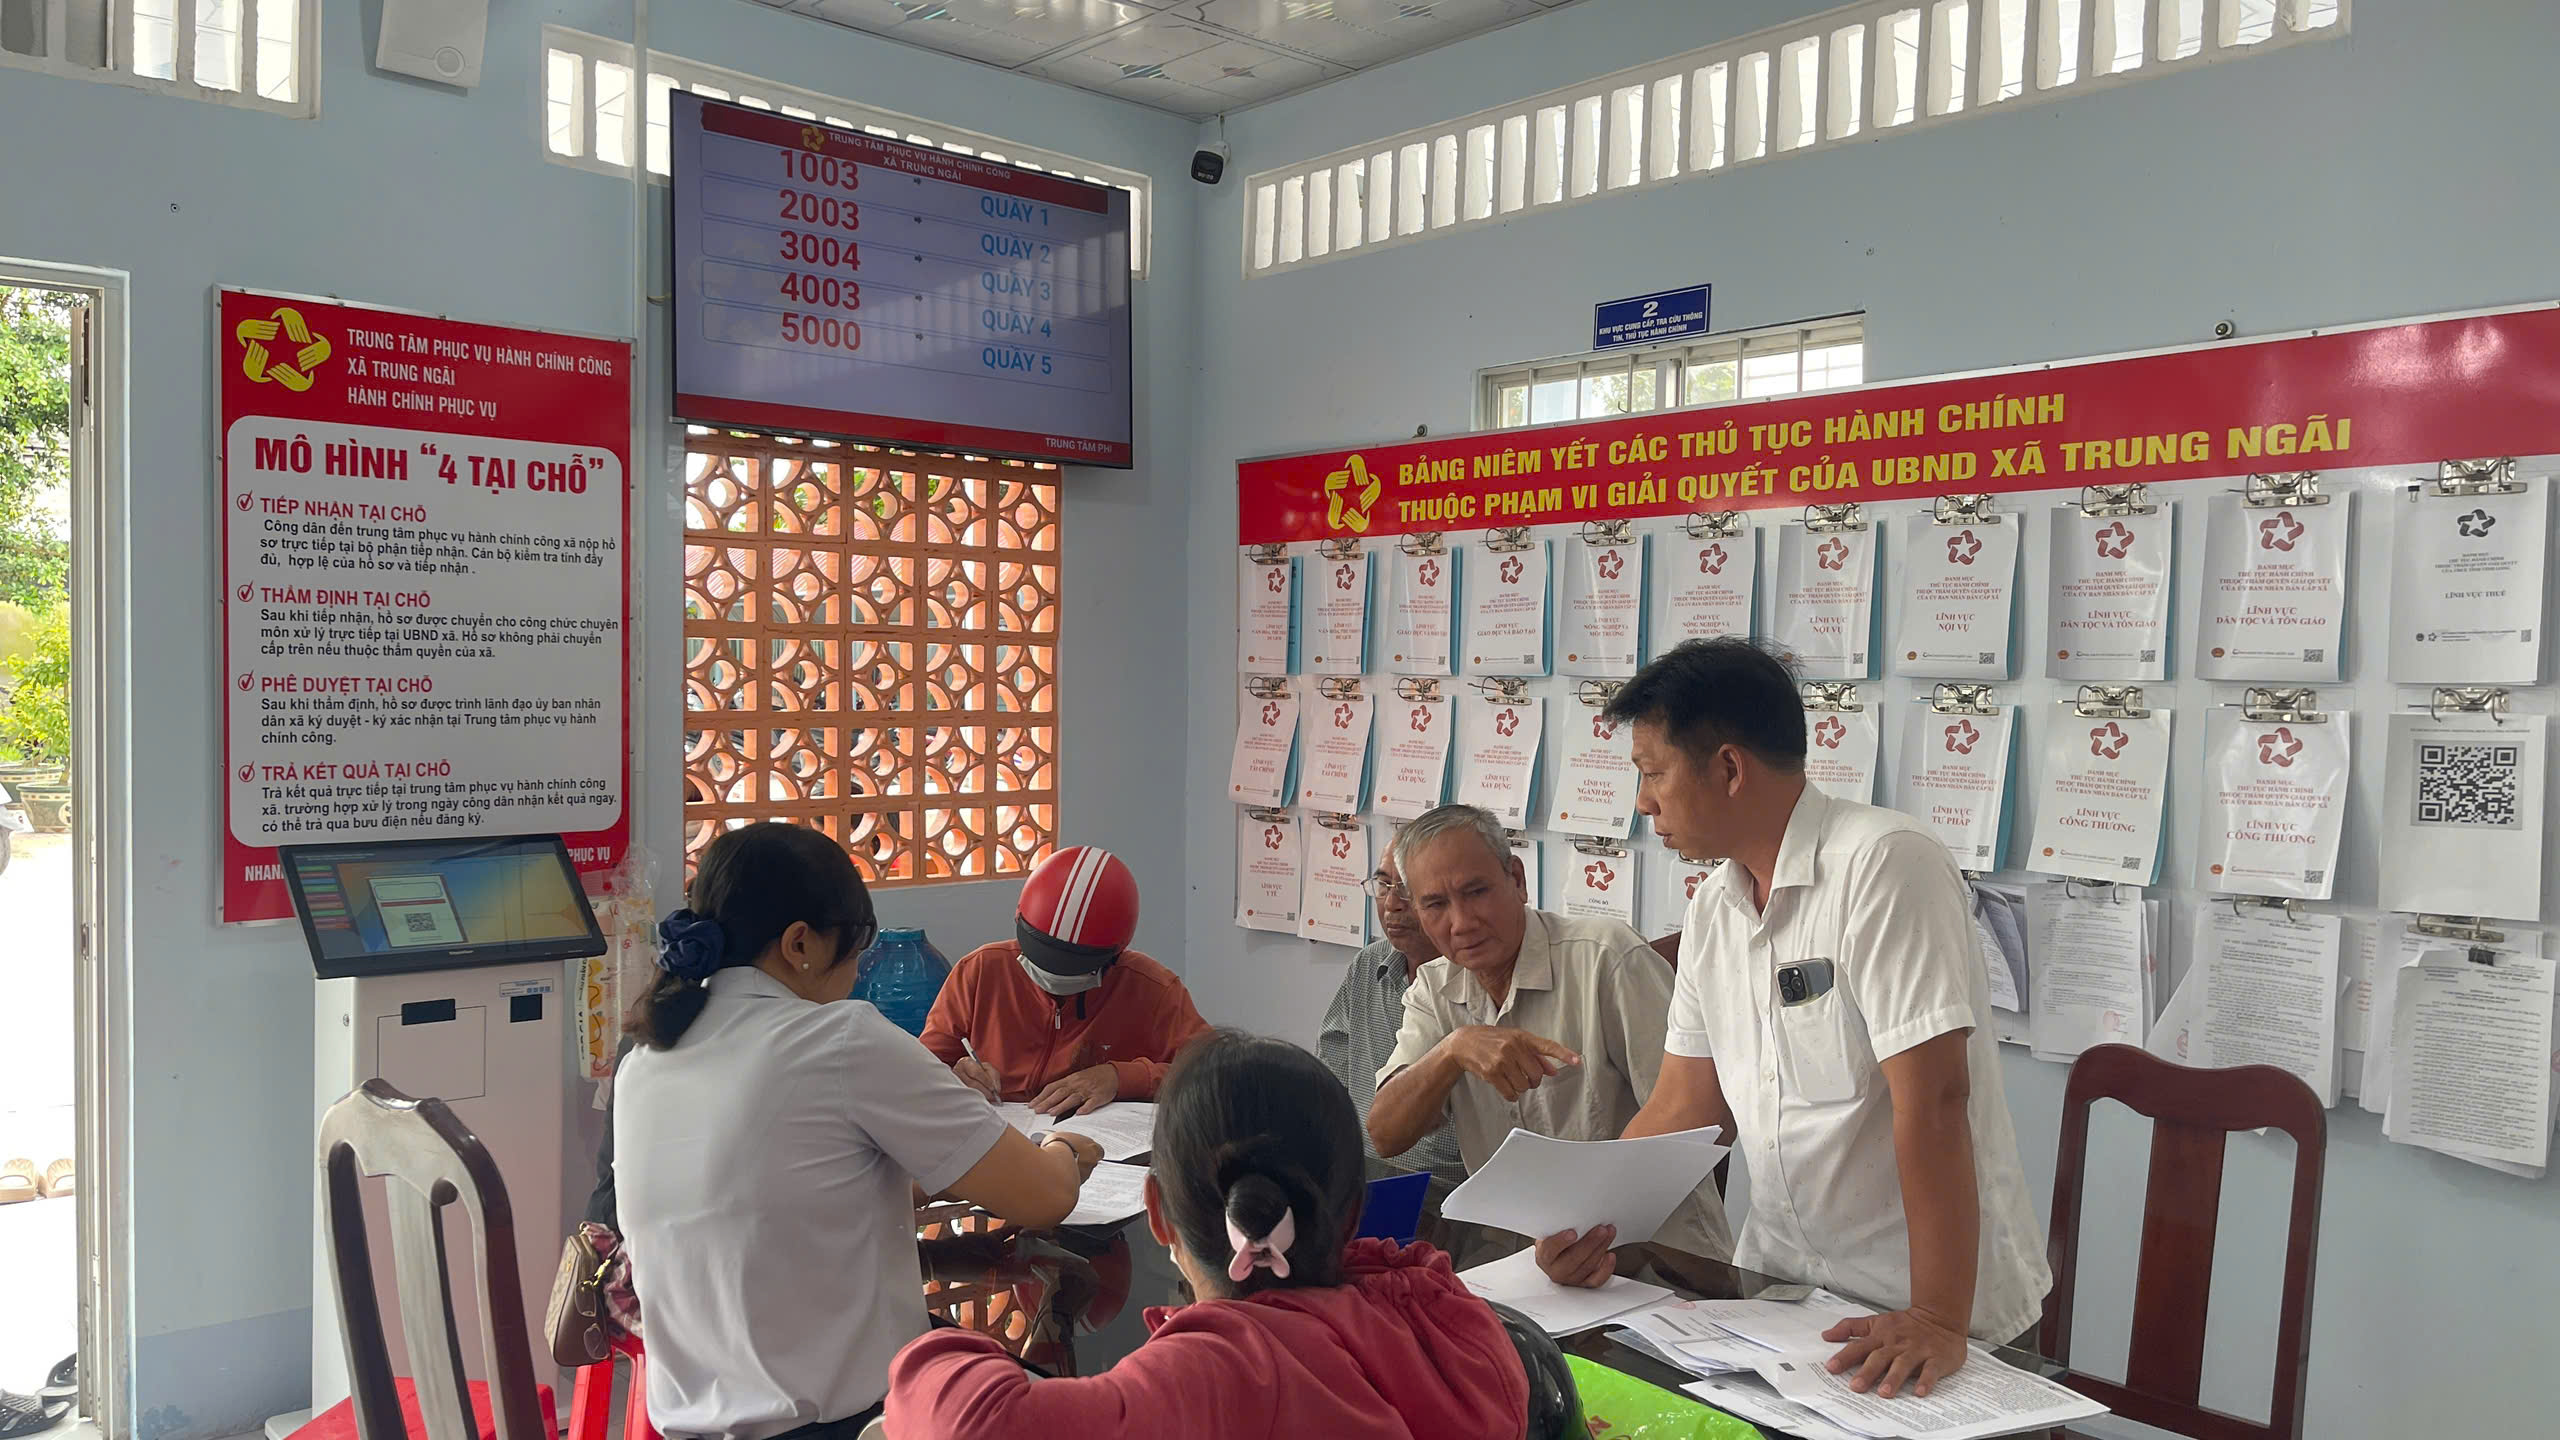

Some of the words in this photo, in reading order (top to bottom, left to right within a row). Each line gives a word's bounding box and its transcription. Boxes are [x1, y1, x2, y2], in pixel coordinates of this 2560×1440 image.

[828, 131, 861, 147] TRUNG
[864, 139, 883, 151] TÂM
[886, 144, 911, 157] PHỤC
[914, 151, 926, 162] VỤ
[986, 167, 1011, 179] CÔNG
[900, 159, 934, 175] TRUNG
[779, 149, 859, 190] 1003
[780, 189, 858, 230] 2003
[1040, 208, 1048, 226] 1
[780, 230, 860, 271] 3004
[1039, 244, 1051, 264] 2
[780, 272, 859, 310] 4003
[1039, 281, 1051, 301] 3
[1642, 301, 1658, 318] 2
[782, 311, 860, 350] 5000
[1040, 319, 1052, 338] 4
[346, 328, 393, 350] TRUNG
[398, 332, 428, 354] TÂM
[433, 339, 468, 361] PHỤC
[473, 344, 491, 365] VỤ
[496, 345, 531, 367] HÀNH
[536, 351, 573, 371] CHÍNH
[578, 355, 611, 376] CÔNG
[347, 355, 366, 376] XÃ
[371, 360, 417, 381] TRUNG
[423, 365, 454, 385] NGÃI
[1041, 355, 1052, 375] 5
[348, 384, 386, 407] HÀNH
[392, 390, 433, 411] CHÍNH
[439, 396, 474, 417] PHỤC
[479, 400, 496, 421] VỤ
[1045, 437, 1075, 450] TRUNG
[1077, 440, 1096, 452] TÂM
[1399, 454, 1464, 485] BẢNG
[1473, 447, 1541, 478] NIÊM
[1550, 436, 1599, 470] YẾT
[1608, 432, 1667, 465] CÁC
[1678, 428, 1737, 458] THỦ
[1748, 420, 1811, 454] TỤC
[1824, 408, 1924, 444] HÀNH
[1938, 393, 2064, 432] CHÍNH
[255, 433, 311, 473] MÔ
[325, 438, 407, 480] HÌNH
[467, 455, 515, 489] TẠI
[1398, 495, 1475, 524] THUỘC
[1484, 487, 1562, 518] PHẠM
[1571, 484, 1597, 509] VI
[1607, 478, 1666, 506] GIẢI
[1678, 468, 1778, 503] QUYẾT
[1789, 461, 1859, 492] CỦA
[1872, 452, 1976, 485] UBND
[1990, 445, 2045, 477] XÃ
[2059, 431, 2208, 471] TRUNG
[2227, 418, 2350, 458] NGÃI
[259, 495, 299, 514] TIẾP
[305, 500, 353, 518] NHẬN
[358, 503, 385, 520] TẠI
[260, 584, 310, 604] THẨM
[316, 589, 357, 608] ĐỊNH
[363, 591, 389, 610] TẠI
[261, 673, 297, 692] PHÊ
[303, 677, 360, 696] DUYỆT
[365, 677, 391, 696] TẠI
[261, 697, 285, 710] Sau
[290, 697, 308, 709] khi
[313, 695, 344, 709] thẩm
[382, 695, 397, 709] hồ
[401, 700, 417, 709] sơ
[420, 698, 451, 712] được
[455, 697, 481, 709] trình
[485, 698, 508, 709] lãnh
[512, 698, 532, 711] đạo
[551, 698, 571, 708] ban
[574, 697, 600, 708] nhân
[261, 714, 285, 726] dân
[289, 714, 303, 726] xã
[308, 714, 322, 729] ký
[326, 714, 361, 728] duyệt
[372, 714, 386, 728] ký
[390, 713, 411, 725] xác
[414, 713, 443, 727] nhận
[446, 714, 460, 727] tại
[463, 713, 496, 727] Trung
[499, 713, 520, 724] tâm
[523, 713, 550, 726] phục
[553, 716, 566, 726] vụ
[570, 713, 596, 723] hành
[261, 731, 297, 743] chính
[301, 730, 336, 745] công.
[261, 761, 298, 781] TRẢ
[303, 761, 337, 780] KẾT
[342, 760, 379, 779] QUẢ
[384, 762, 410, 777] TẠI
[567, 847, 594, 865] PHỤC
[597, 846, 610, 864] VỤ
